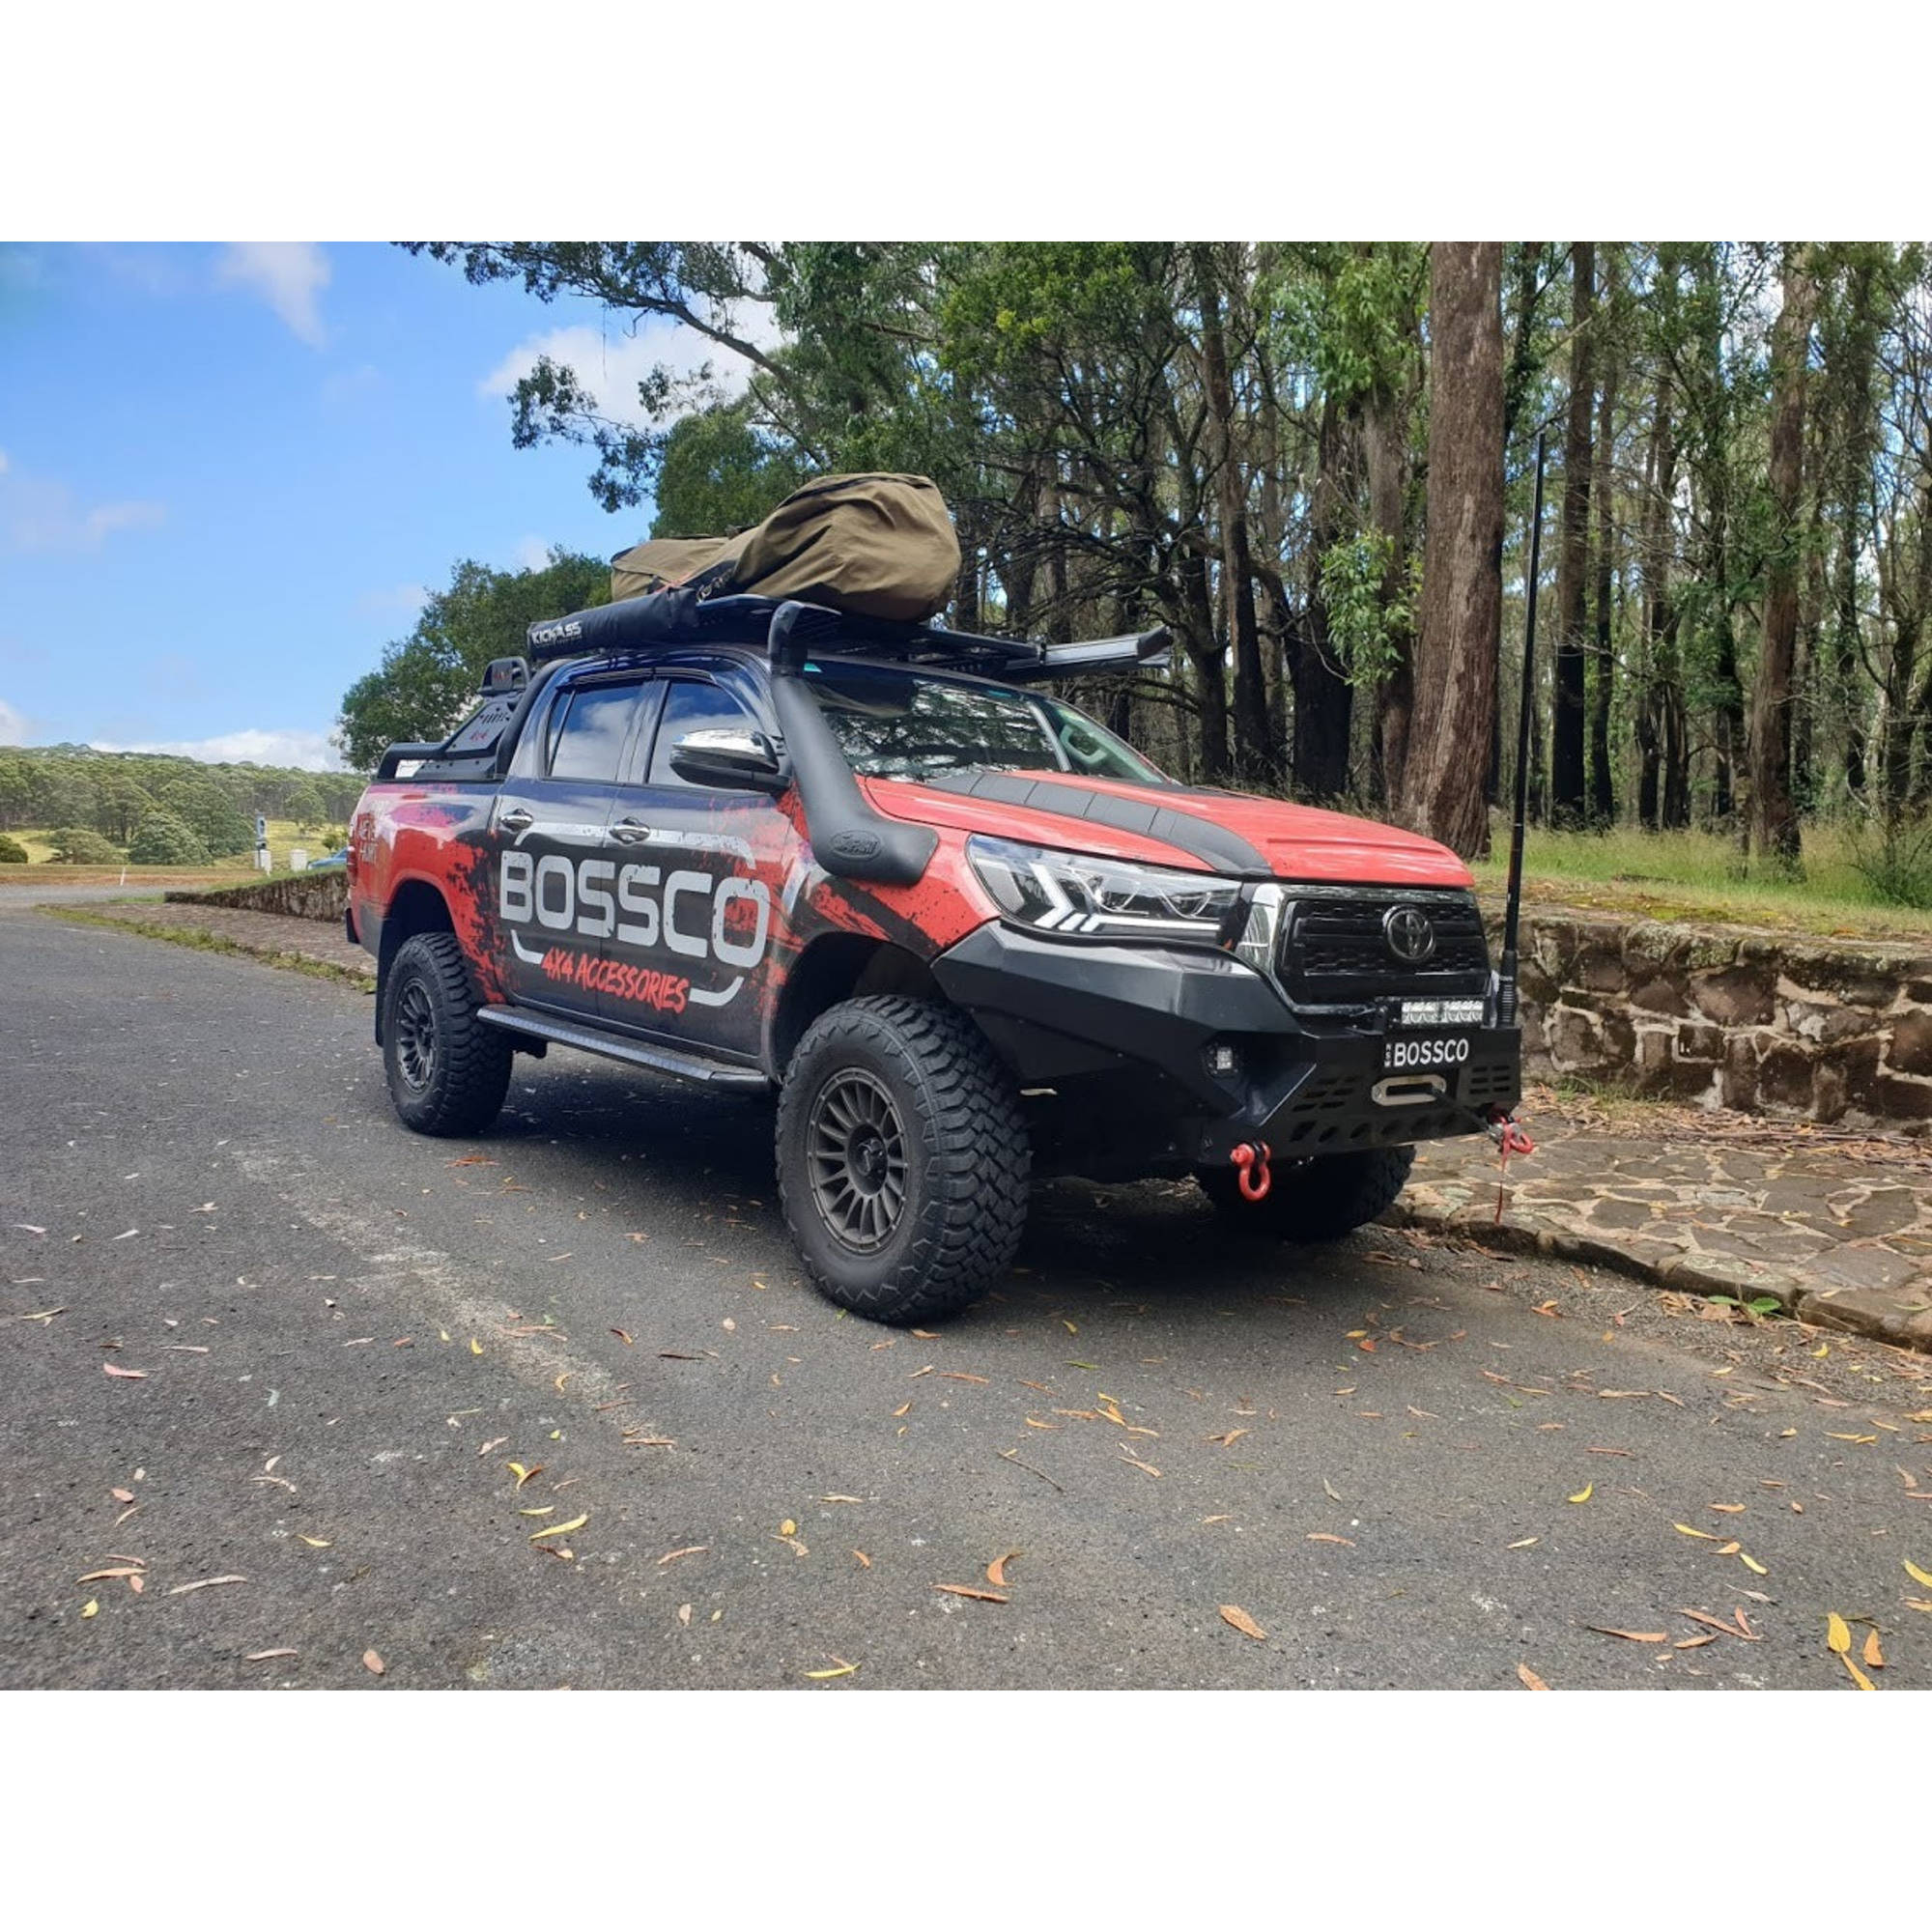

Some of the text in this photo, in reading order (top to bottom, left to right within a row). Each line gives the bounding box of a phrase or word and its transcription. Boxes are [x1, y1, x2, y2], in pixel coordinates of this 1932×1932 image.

[500, 851, 770, 967] BOSSCO
[576, 953, 690, 1013] ACCESSORIES
[1394, 1038, 1468, 1067] BOSSCO
